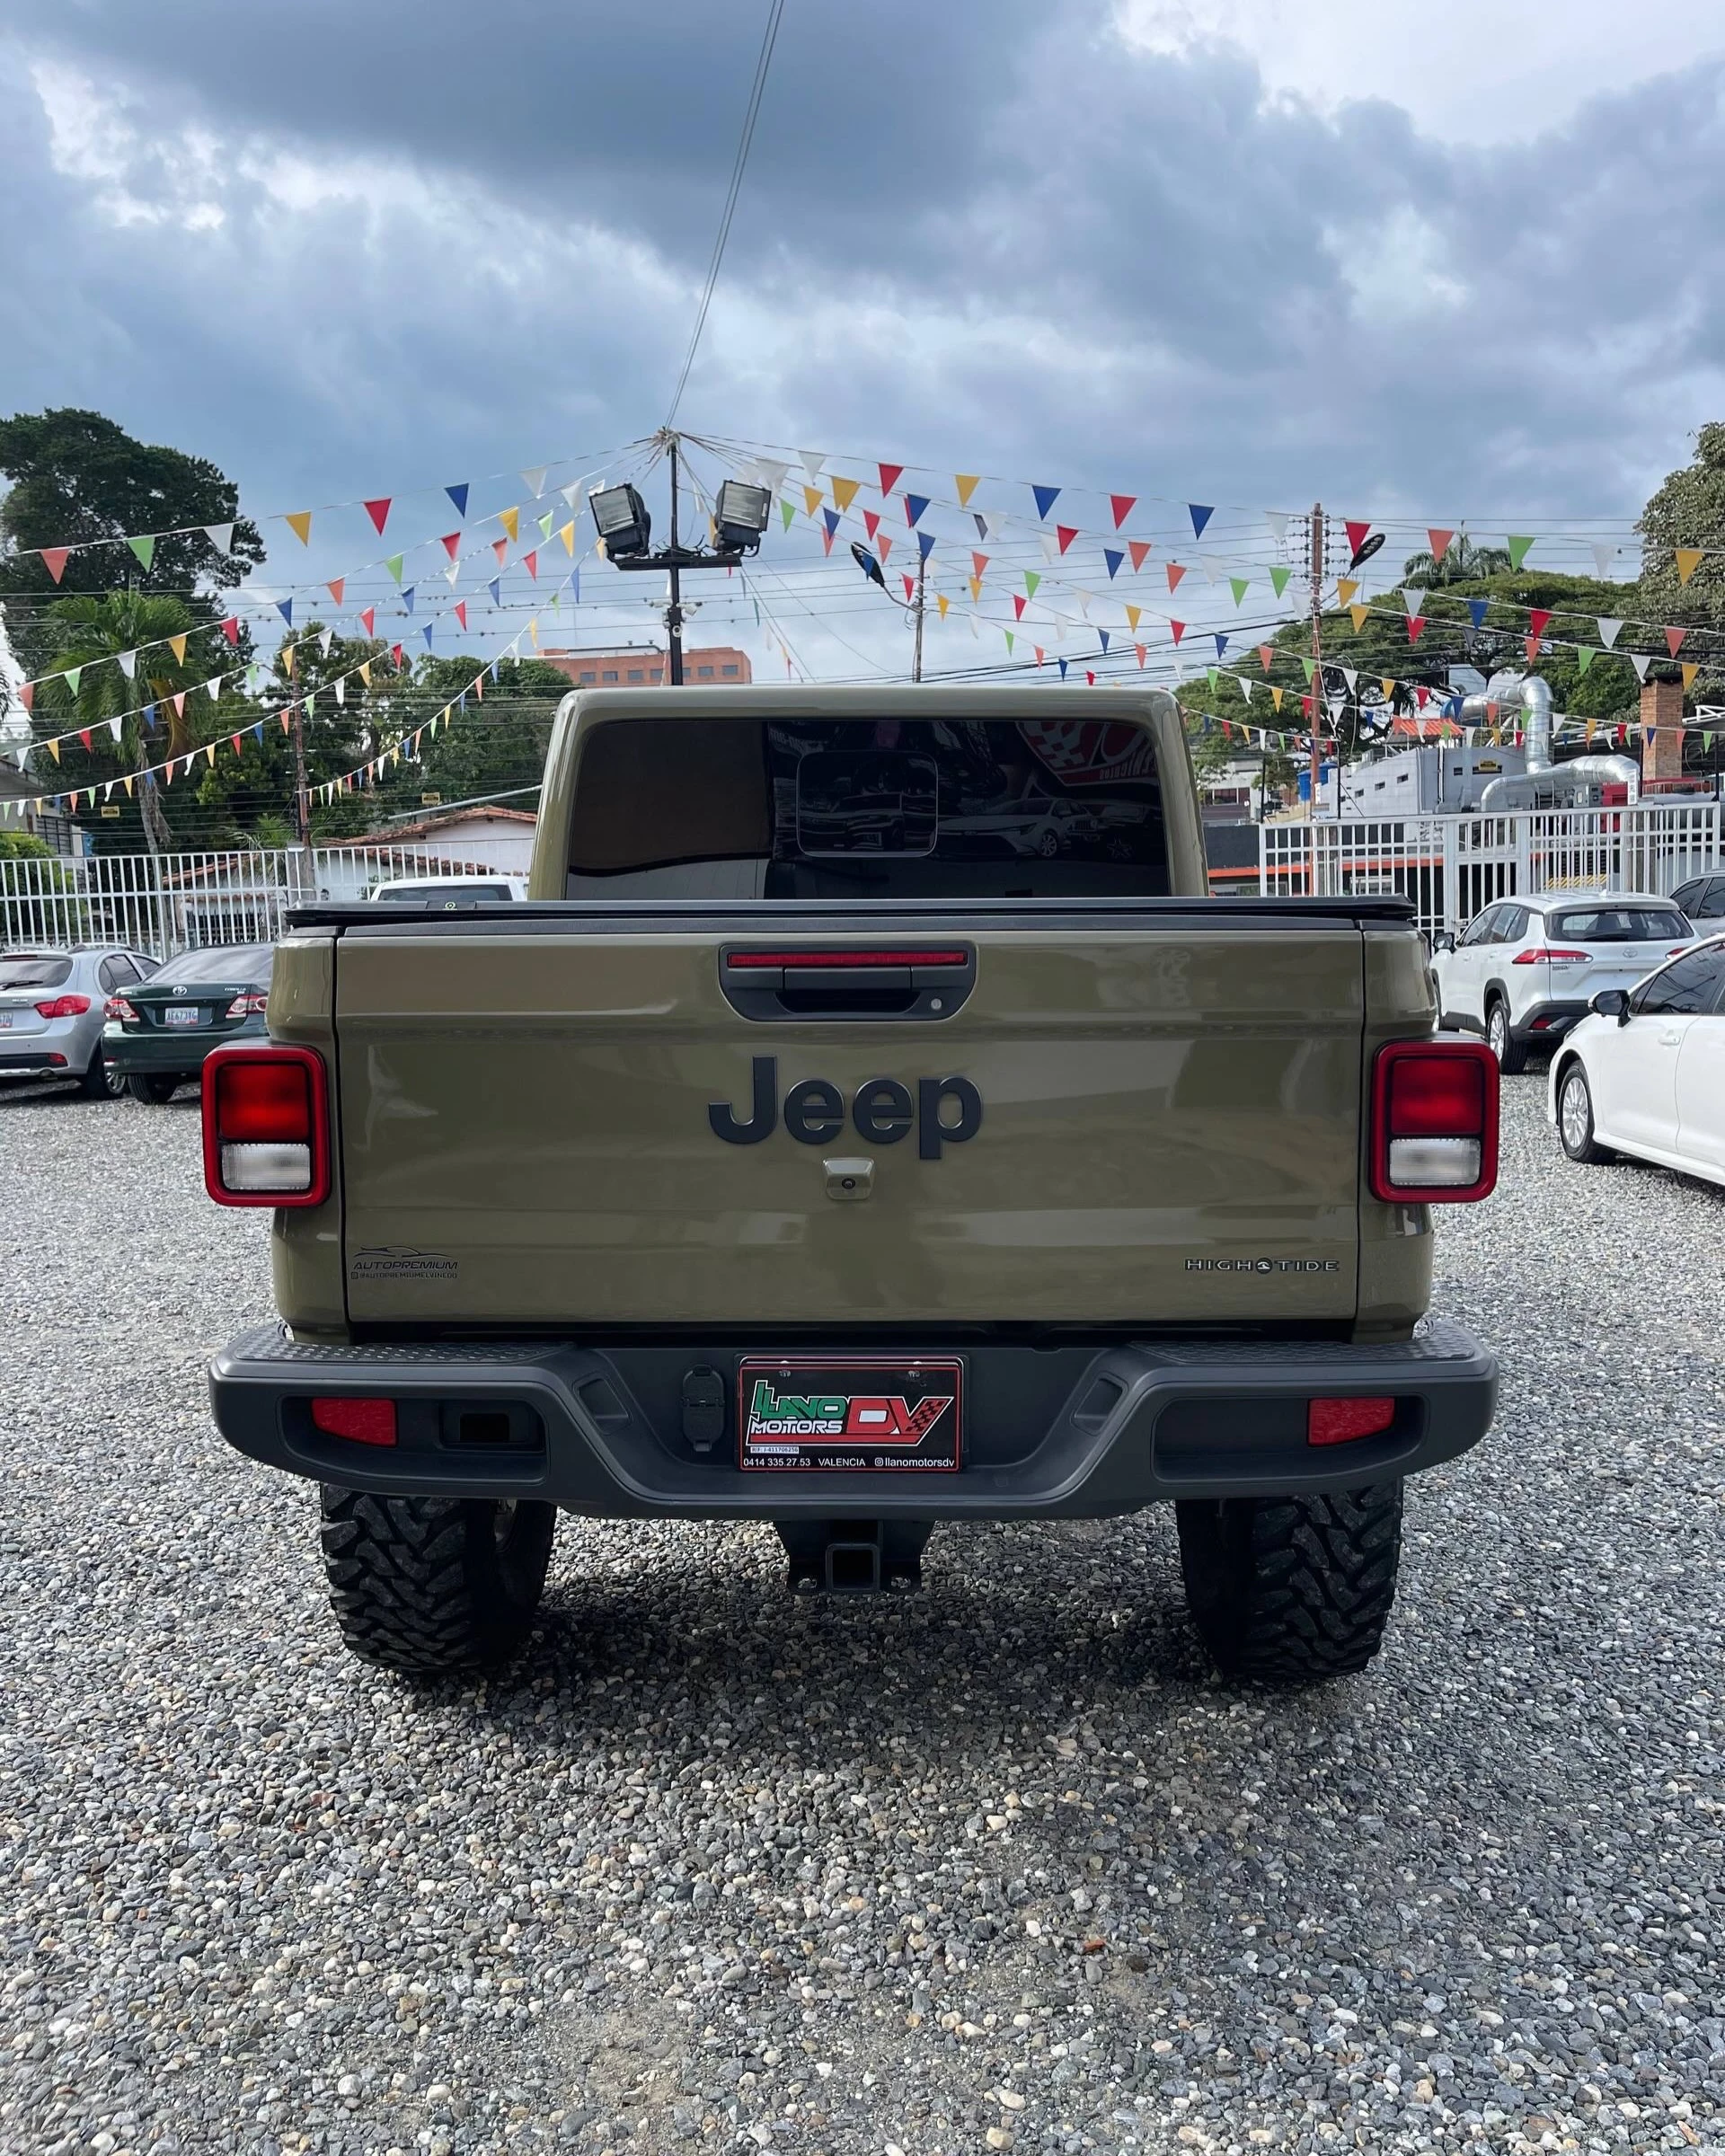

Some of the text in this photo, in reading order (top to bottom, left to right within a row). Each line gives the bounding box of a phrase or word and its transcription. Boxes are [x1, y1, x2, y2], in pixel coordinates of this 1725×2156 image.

[708, 1056, 983, 1160] Jeep
[353, 1261, 459, 1270] AUTOPREMIUM
[1185, 1259, 1340, 1272] HIGH TIDE
[753, 1381, 847, 1419] LLANO
[846, 1398, 951, 1435] DV
[750, 1419, 844, 1435] MOTORS
[743, 1457, 955, 1468] 0414 335.27.53 VALENCIA llanomotorsdv
